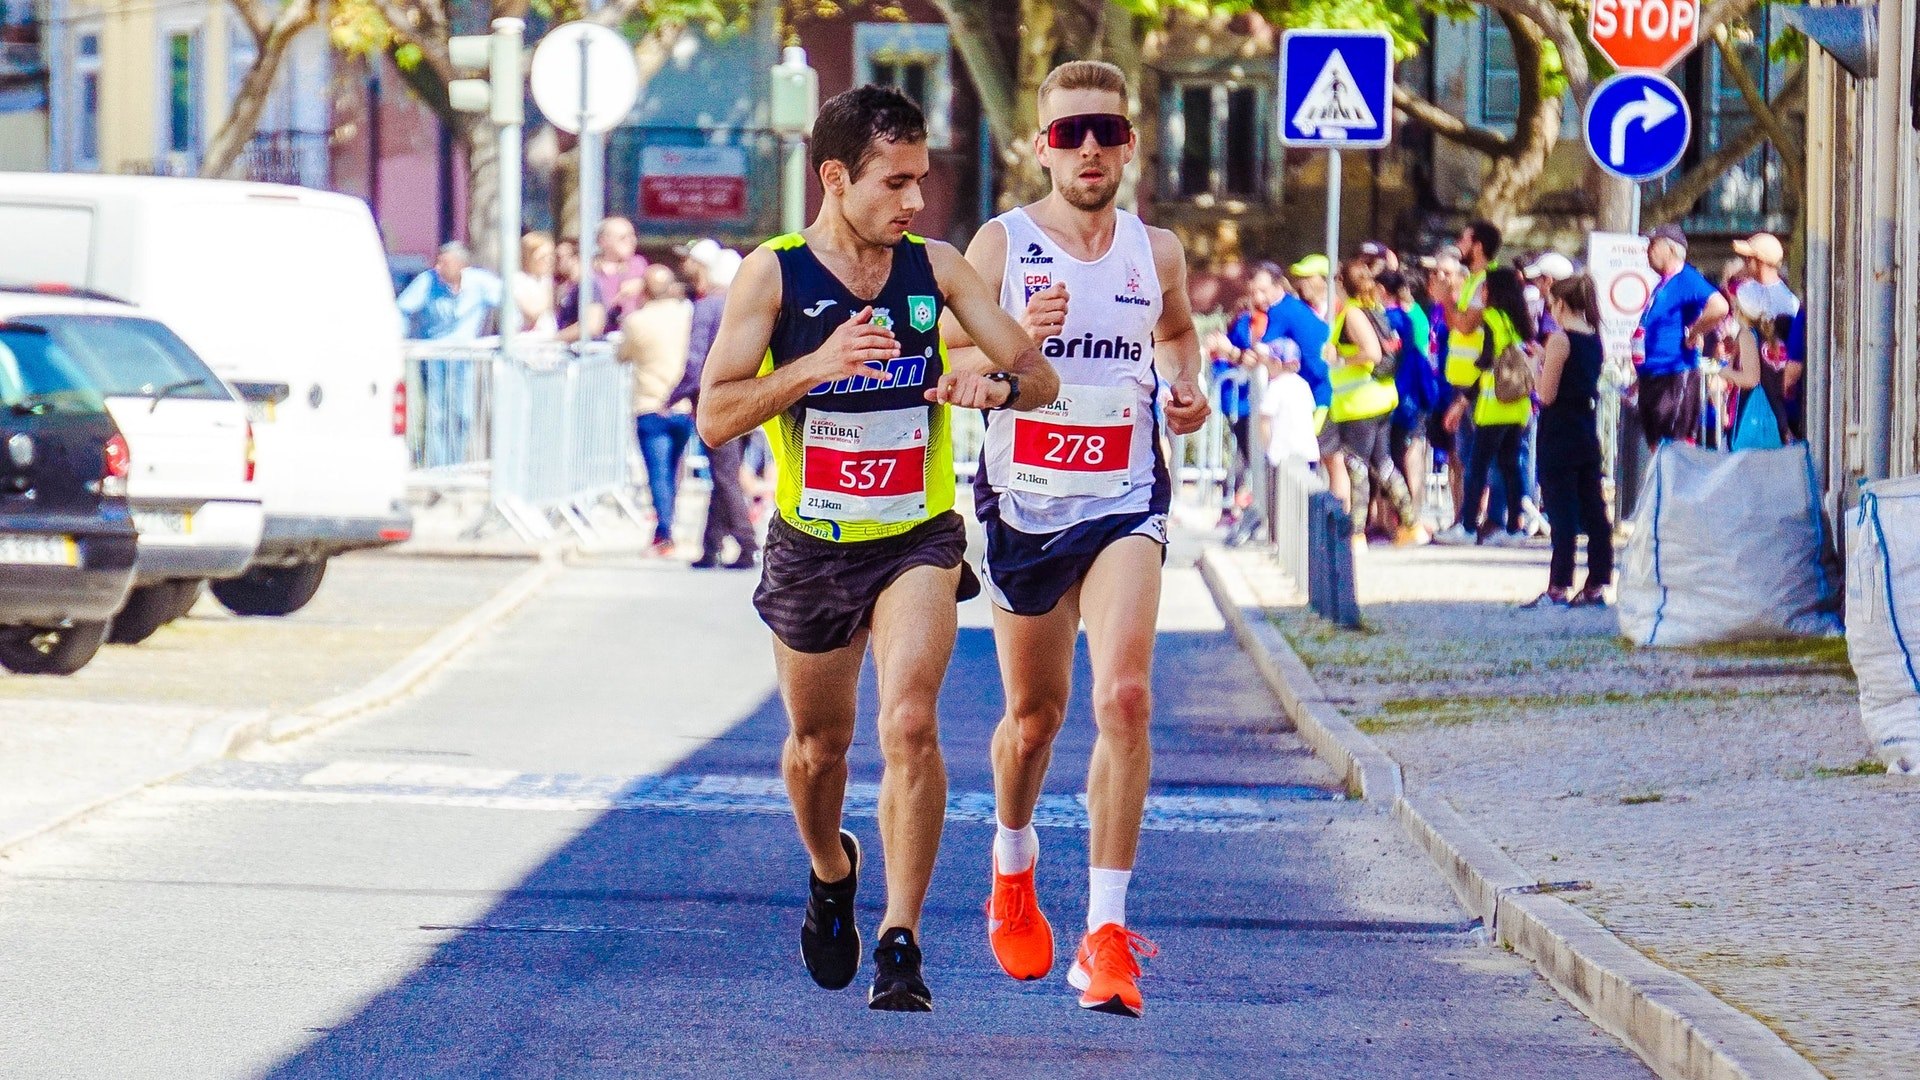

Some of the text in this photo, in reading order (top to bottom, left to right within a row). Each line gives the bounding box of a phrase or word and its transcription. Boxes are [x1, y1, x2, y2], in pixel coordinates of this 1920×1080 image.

[1595, 0, 1694, 41] STOP
[1020, 256, 1053, 264] VIATOR
[1026, 275, 1050, 285] CPA
[1115, 294, 1150, 306] Marinha
[1039, 332, 1142, 361] arinha
[1044, 432, 1106, 465] 278
[839, 458, 898, 490] 537
[1016, 471, 1048, 485] 21,1km
[808, 497, 842, 510] 21,1km
